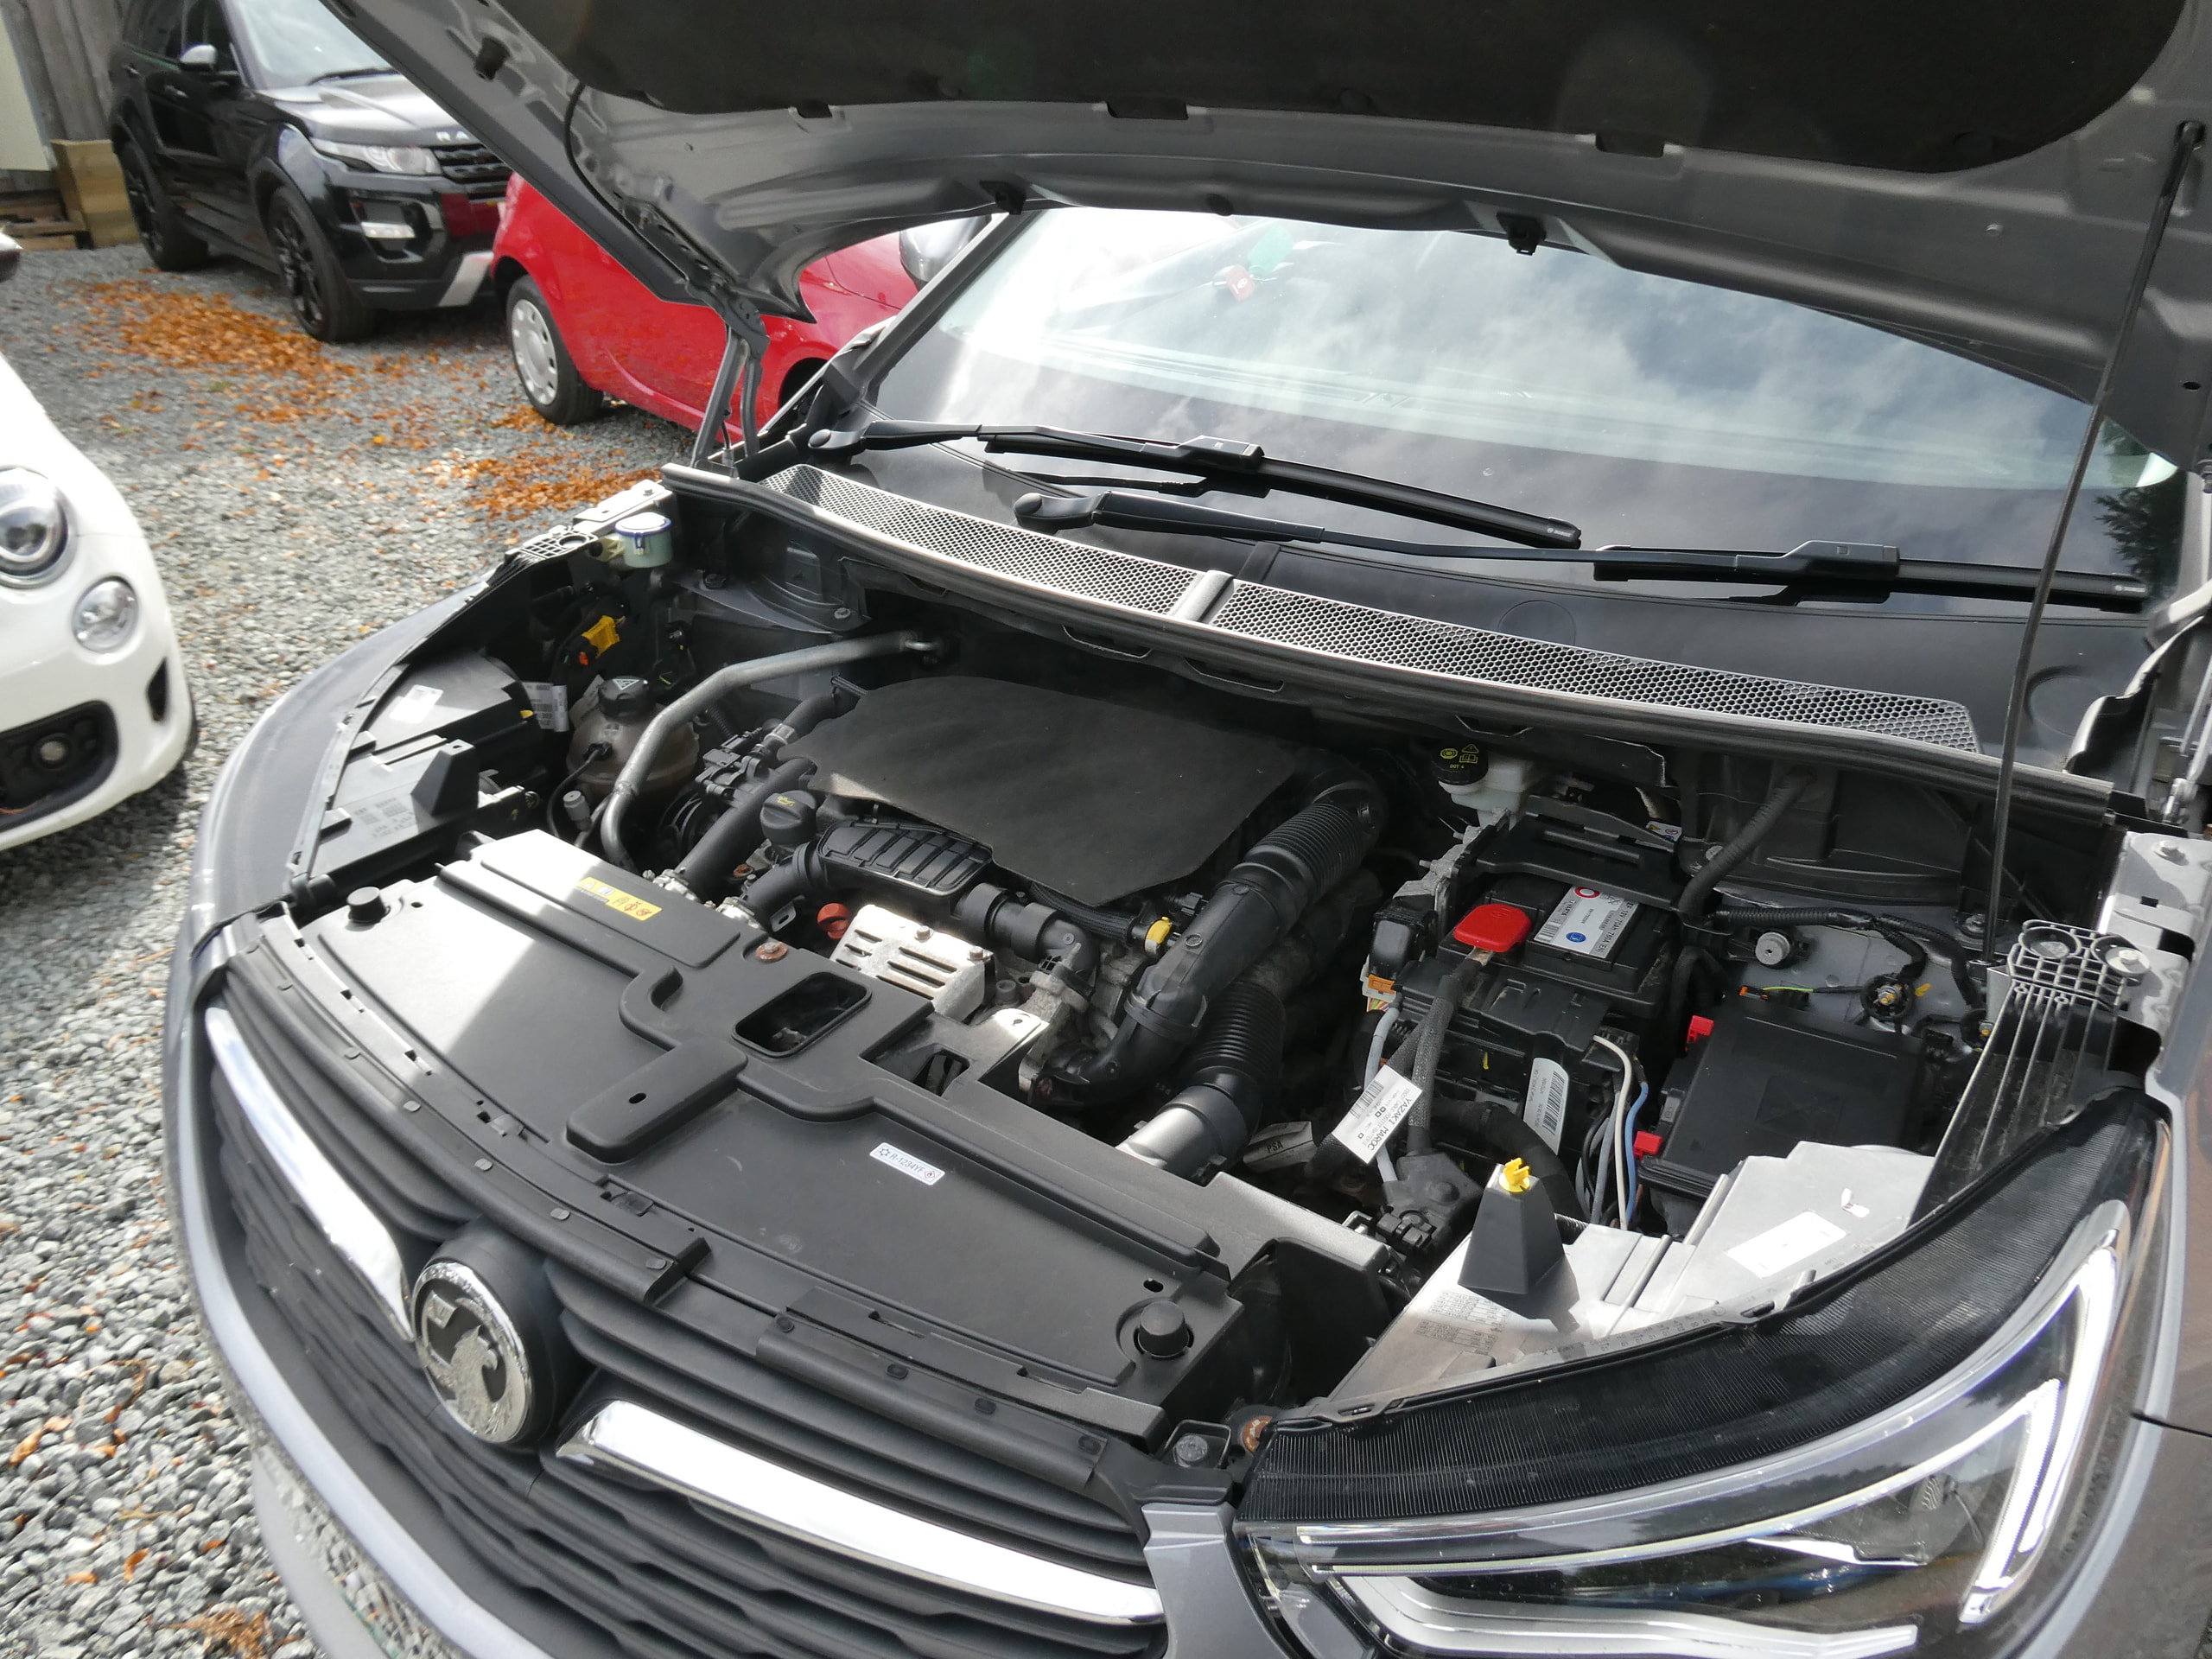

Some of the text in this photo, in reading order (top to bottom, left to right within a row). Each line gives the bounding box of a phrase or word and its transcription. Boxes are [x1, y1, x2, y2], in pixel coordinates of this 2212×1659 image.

[1390, 1097, 1413, 1126] YAZAKI
[1266, 1140, 1284, 1154] PSA
[1368, 1125, 1389, 1151] MAROC
